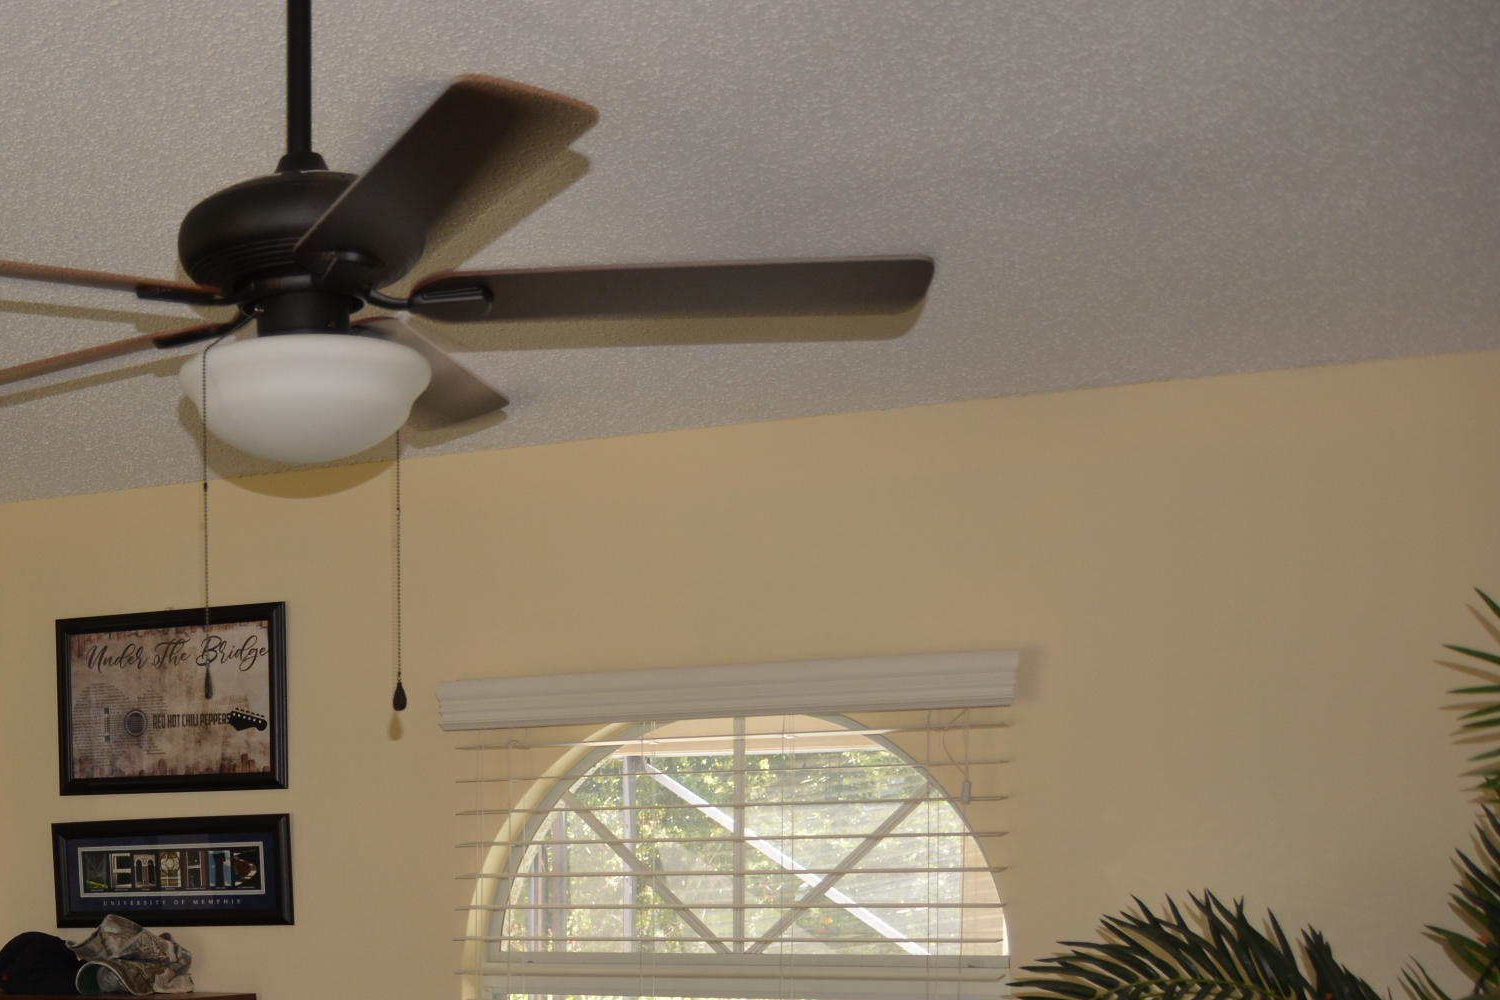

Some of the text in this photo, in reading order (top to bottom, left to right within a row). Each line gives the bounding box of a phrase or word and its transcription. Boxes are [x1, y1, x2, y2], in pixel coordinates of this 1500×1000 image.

[86, 634, 269, 673] Under The Bridge
[152, 710, 232, 730] RED HOT CHILI PEPPERS
[102, 897, 243, 906] UNIVERSITY OF MEMPHIS
